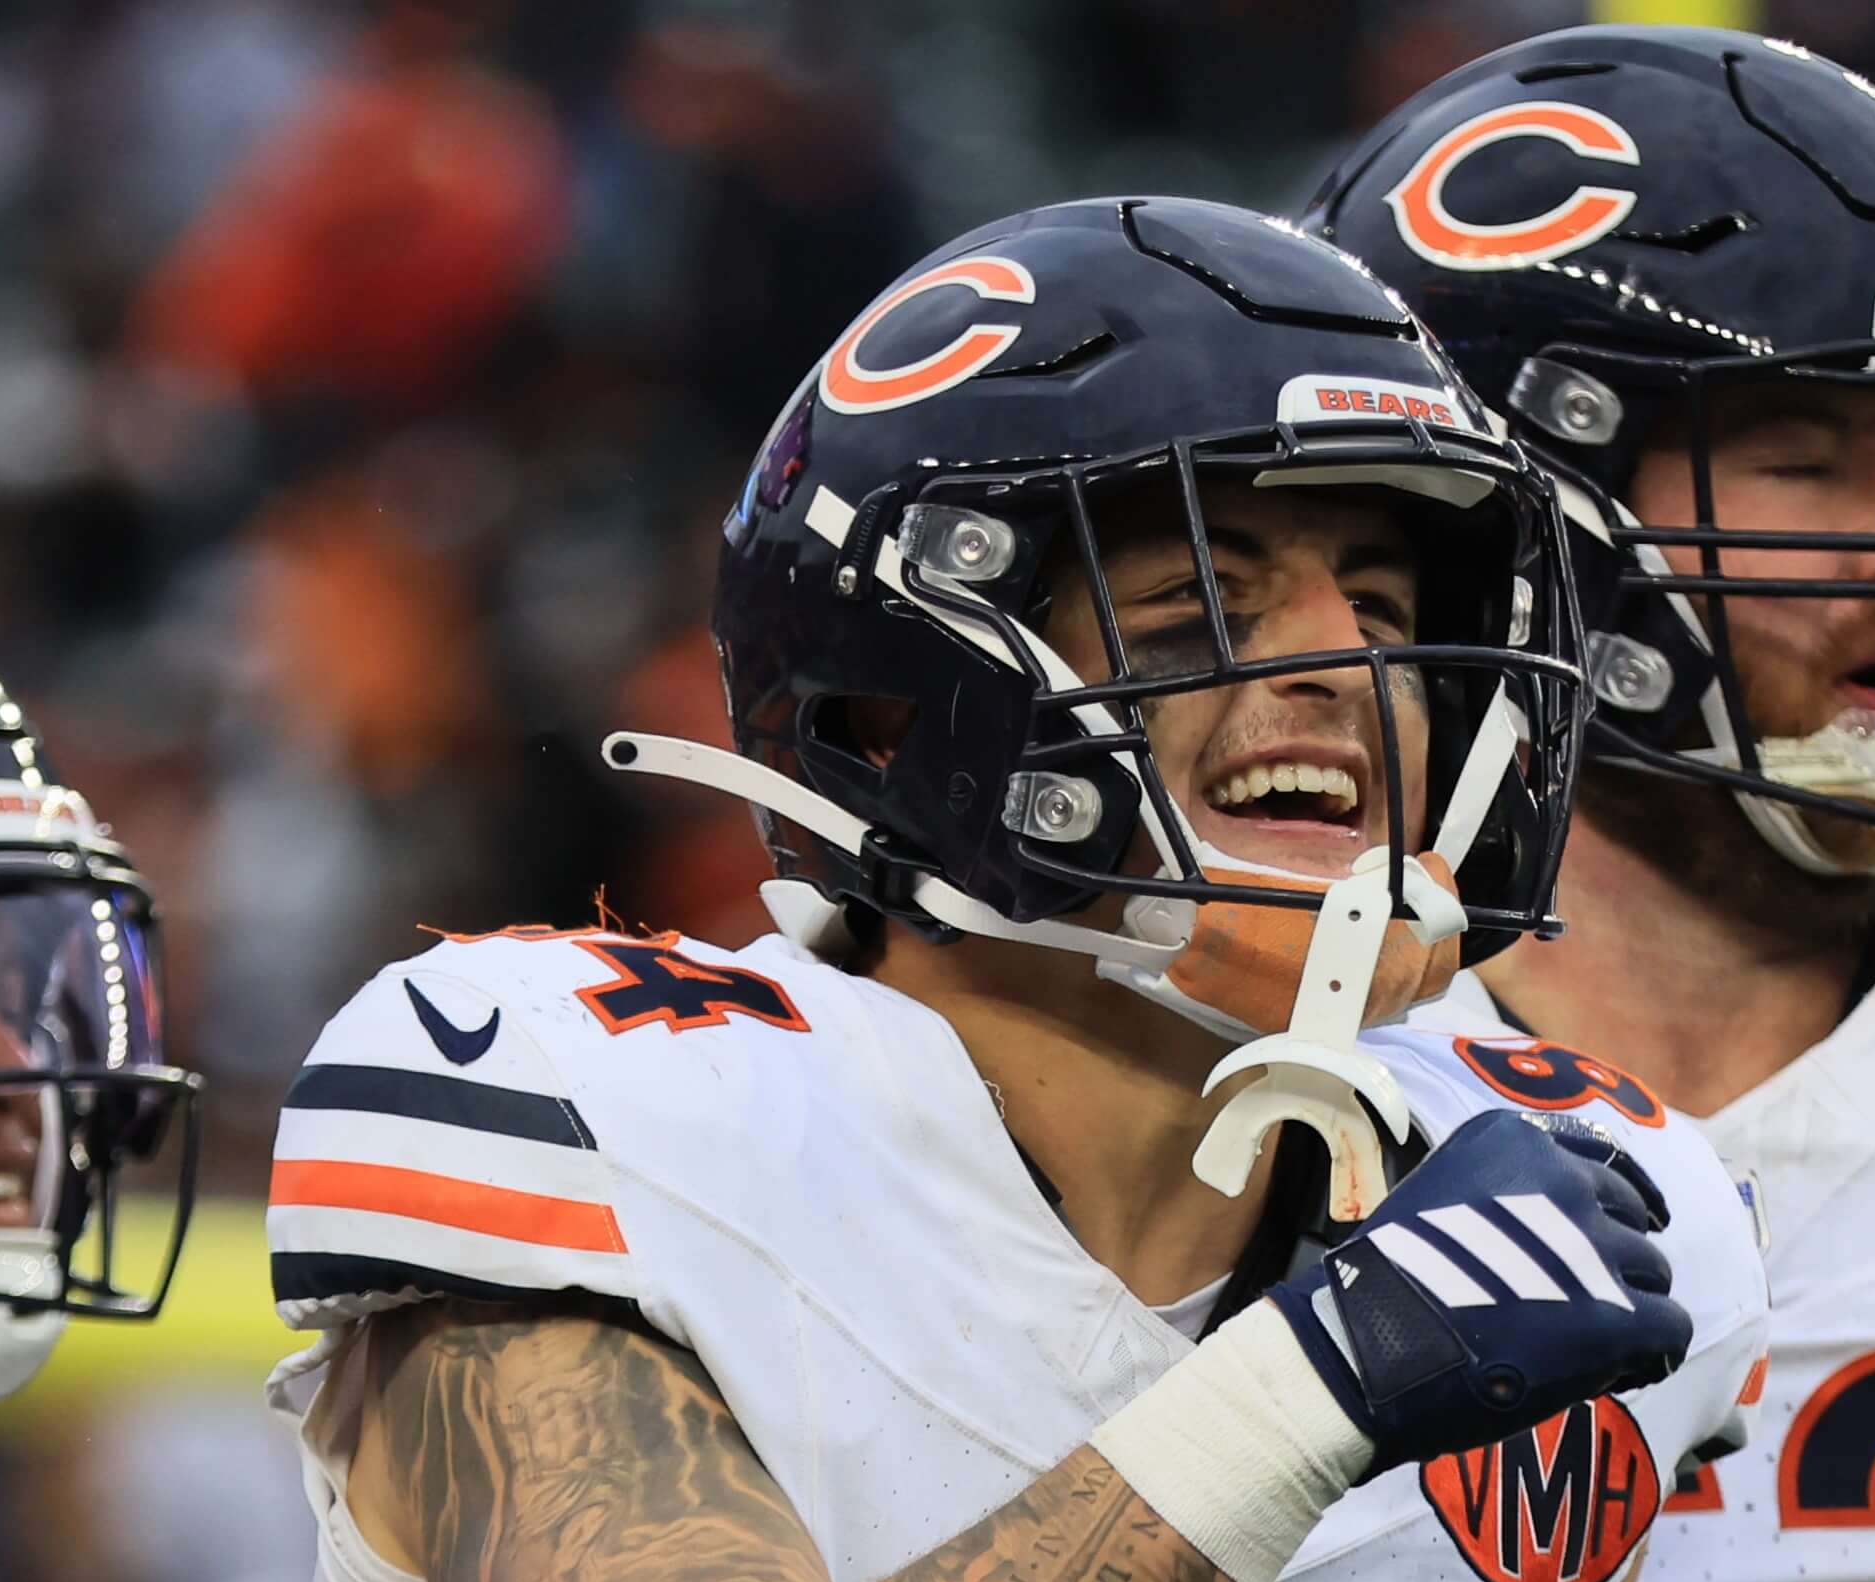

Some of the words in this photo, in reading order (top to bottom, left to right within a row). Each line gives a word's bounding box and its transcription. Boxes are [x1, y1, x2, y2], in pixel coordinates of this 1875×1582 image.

[1383, 100, 1641, 272] C
[819, 256, 1036, 415] C
[1315, 388, 1456, 426] BEARS
